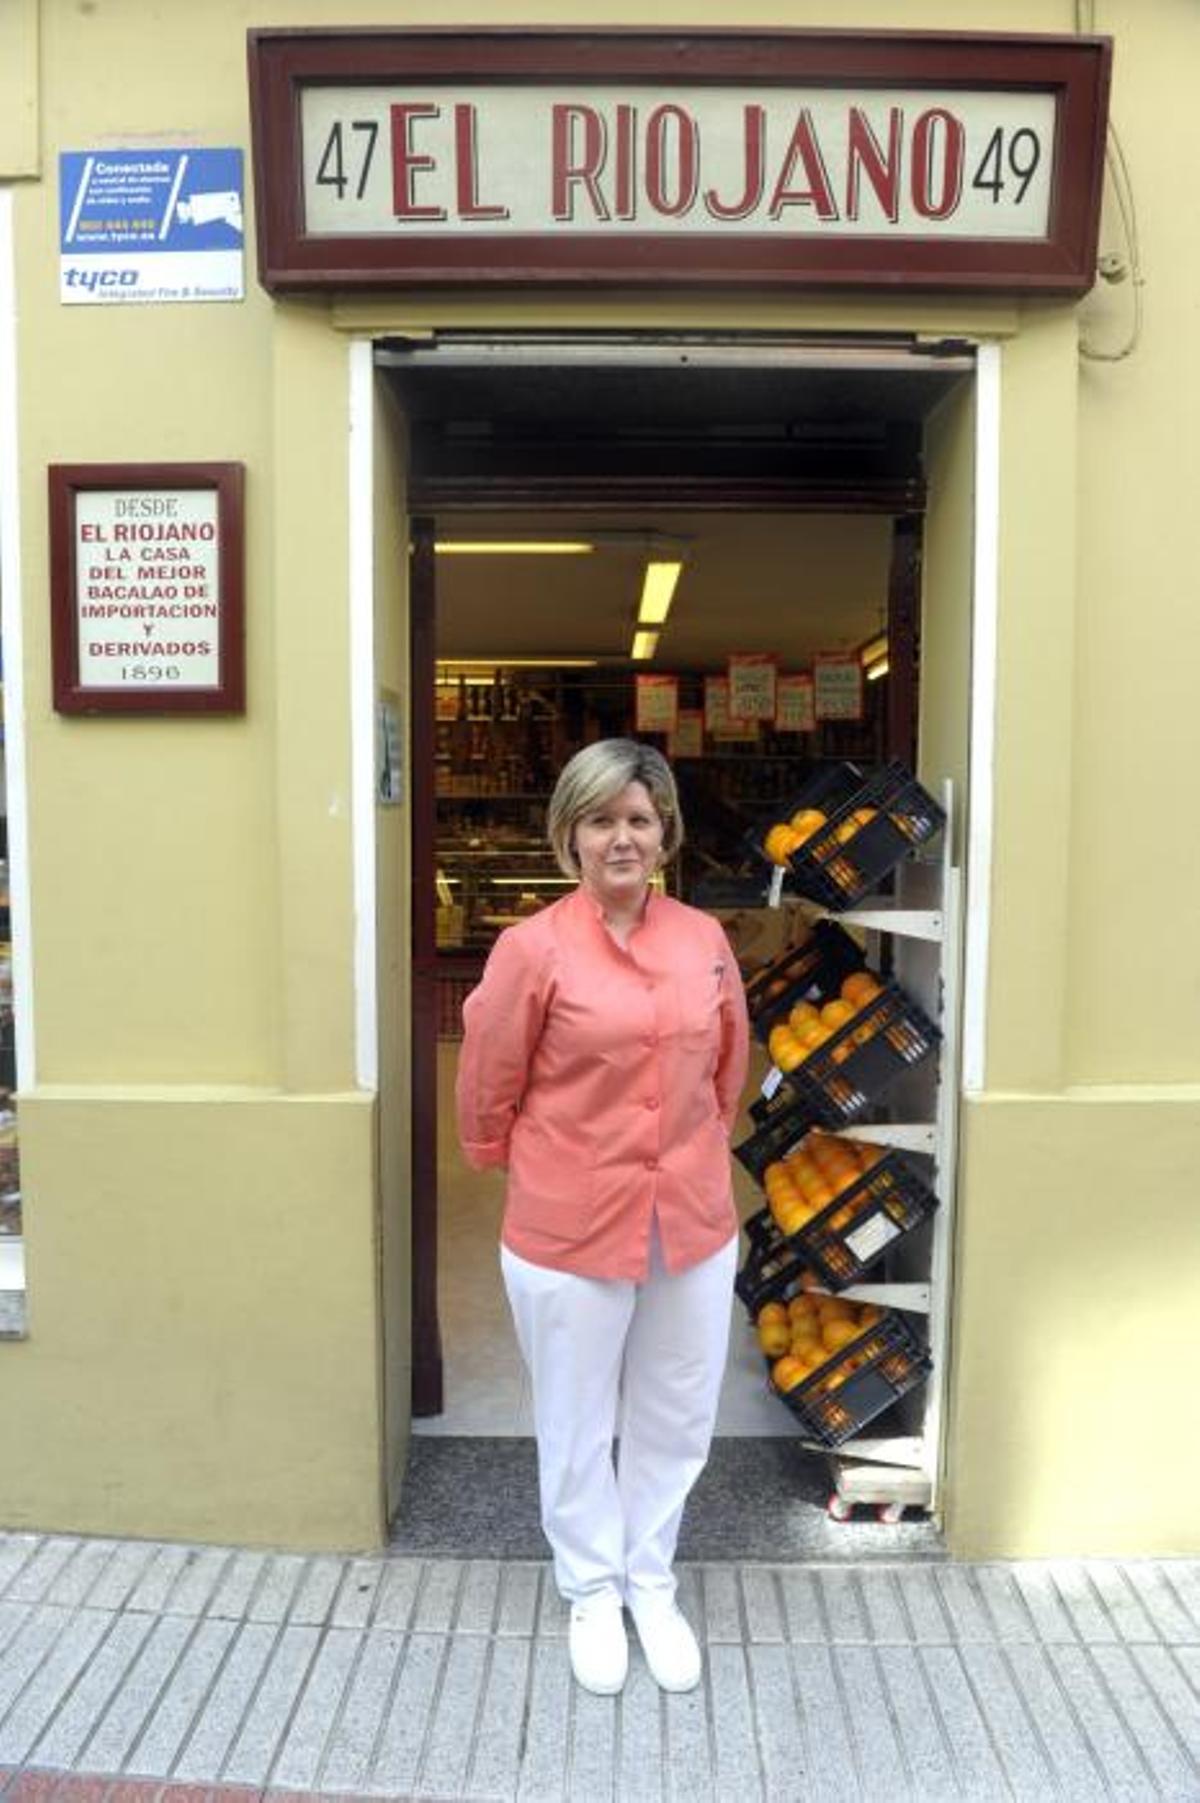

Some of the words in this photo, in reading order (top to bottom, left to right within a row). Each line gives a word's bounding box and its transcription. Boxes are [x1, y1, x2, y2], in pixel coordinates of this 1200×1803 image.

[315, 121, 379, 200] 47
[389, 102, 510, 222] EL
[550, 102, 966, 224] RIOJANO
[972, 126, 1041, 204] 49
[63, 268, 140, 292] tyco
[114, 498, 178, 518] DESDE
[80, 524, 107, 543] EL
[114, 523, 215, 542] RIOJANO
[105, 547, 131, 561] LA
[140, 547, 191, 561] CASA
[89, 566, 127, 580] DEL
[137, 565, 206, 580] MEJOR
[88, 585, 179, 600] BACALAO
[183, 584, 209, 599] DE
[142, 624, 155, 637] Y
[88, 641, 211, 657] DERIVADOS
